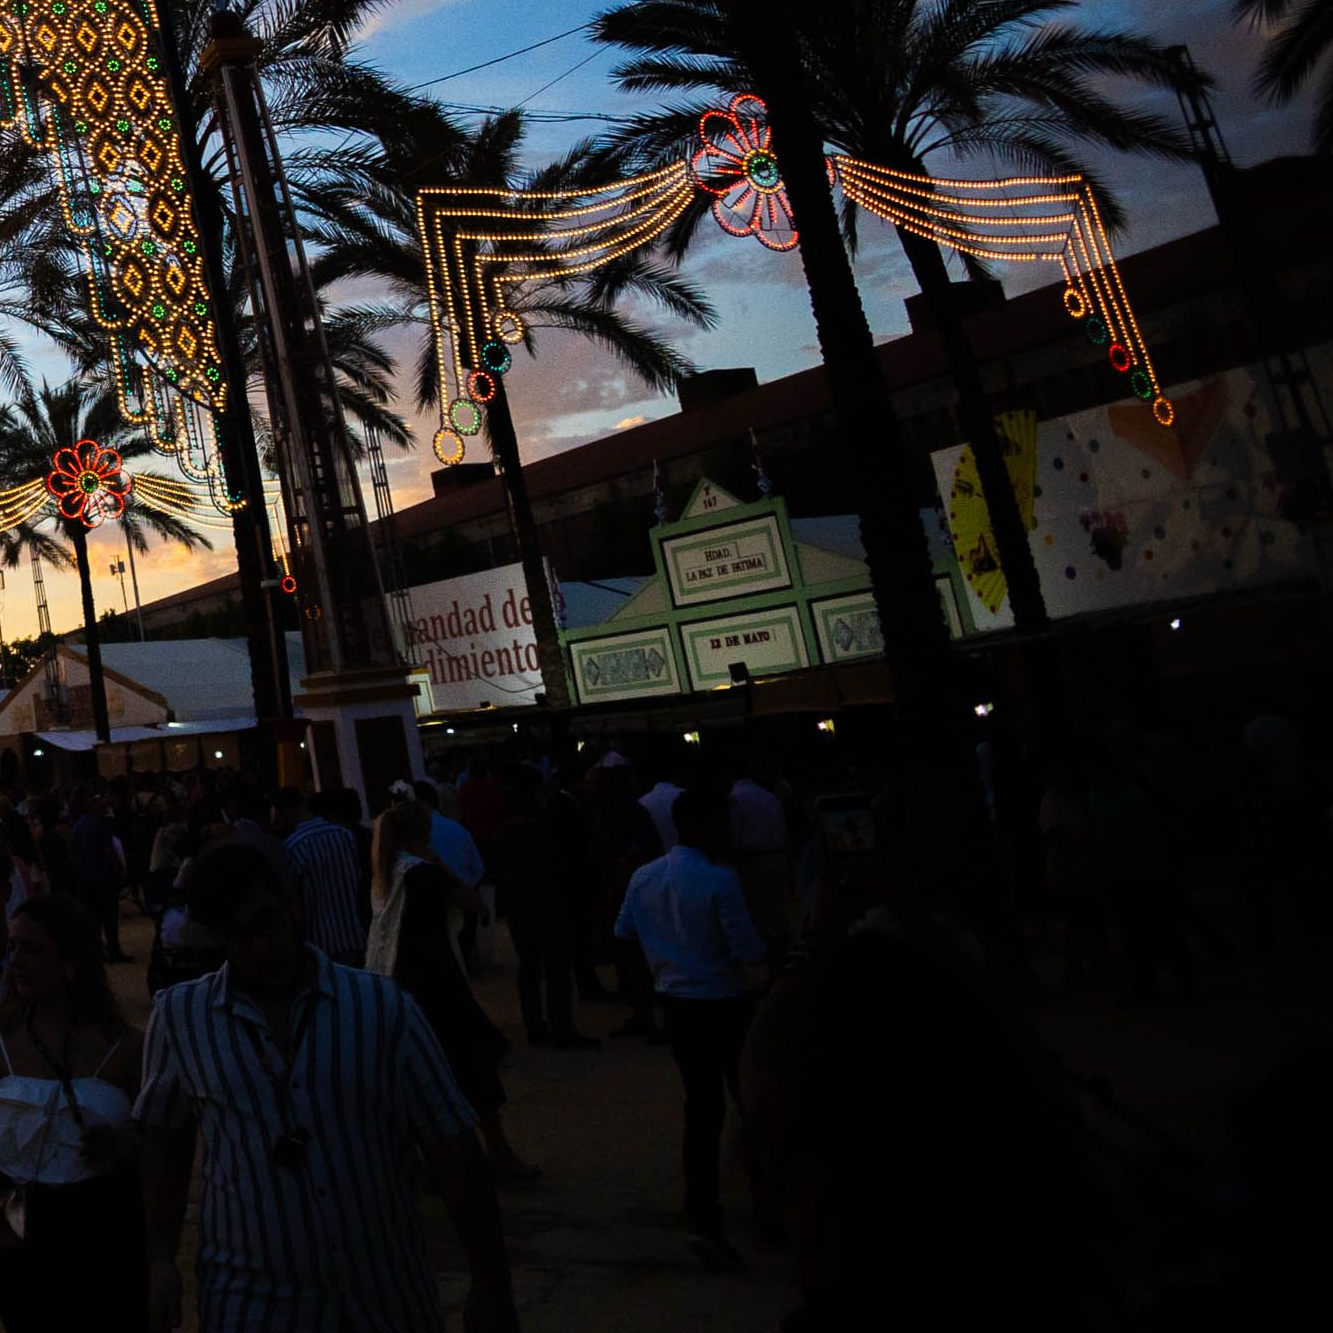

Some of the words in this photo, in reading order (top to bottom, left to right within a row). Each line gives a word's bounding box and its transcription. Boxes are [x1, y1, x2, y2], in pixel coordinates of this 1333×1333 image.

[698, 567, 713, 580] PAZ
[716, 565, 728, 575] DE
[725, 635, 741, 647] DE
[743, 630, 770, 644] MAYO
